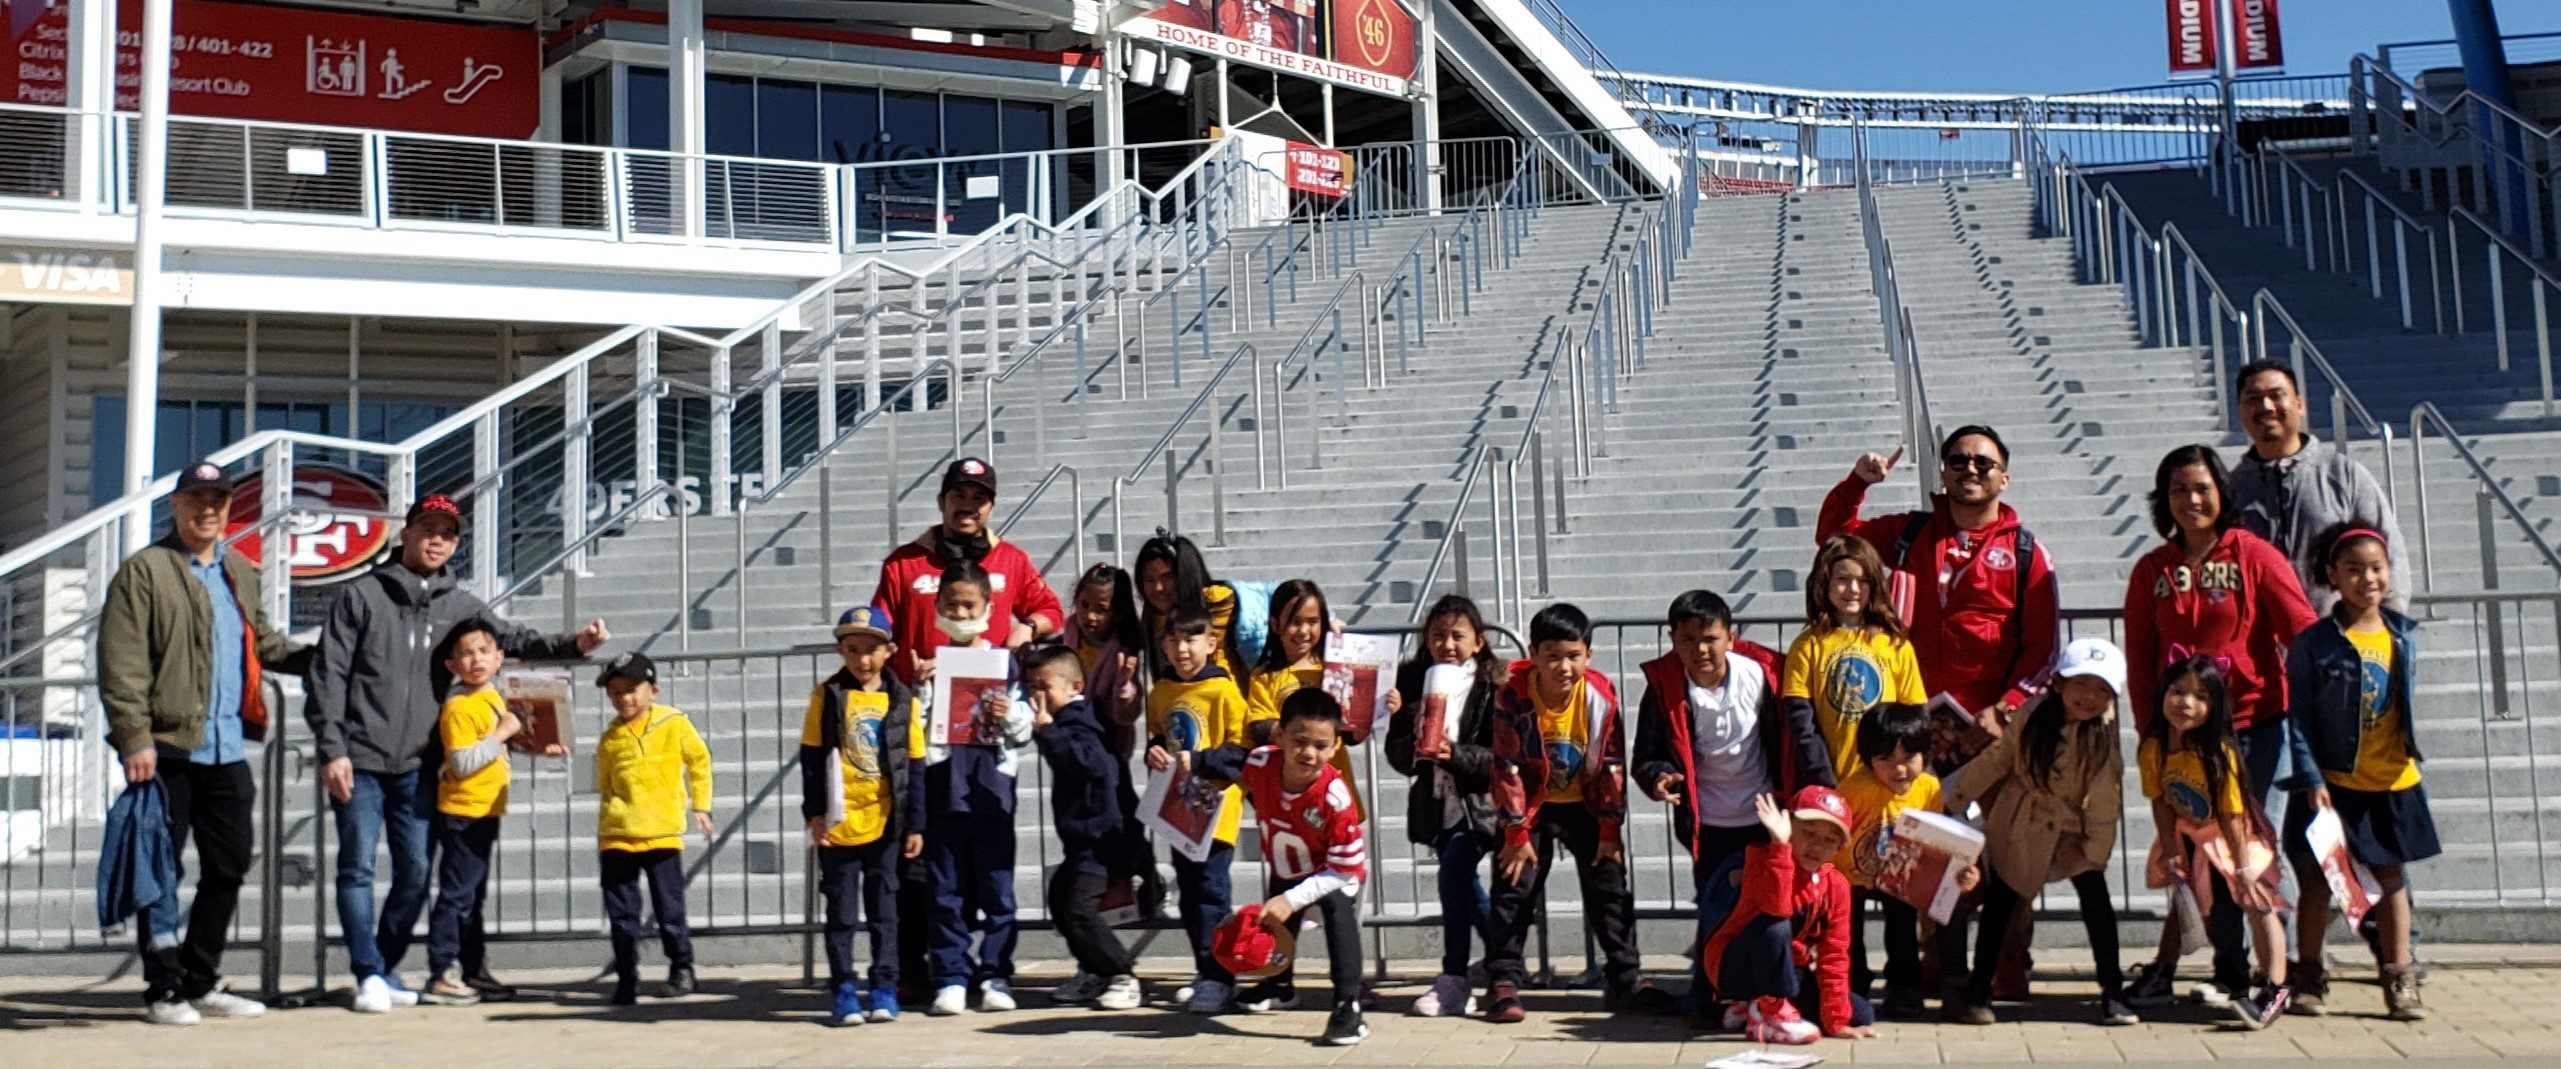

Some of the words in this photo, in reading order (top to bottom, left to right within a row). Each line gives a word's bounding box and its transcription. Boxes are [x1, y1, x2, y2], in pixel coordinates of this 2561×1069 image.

[1156, 24, 1220, 51] HOME
[1226, 40, 1252, 58] OF
[1252, 48, 1297, 69] THE
[1302, 59, 1396, 92] FAITHFUL
[213, 78, 250, 96] Club
[12, 251, 121, 294] VISA
